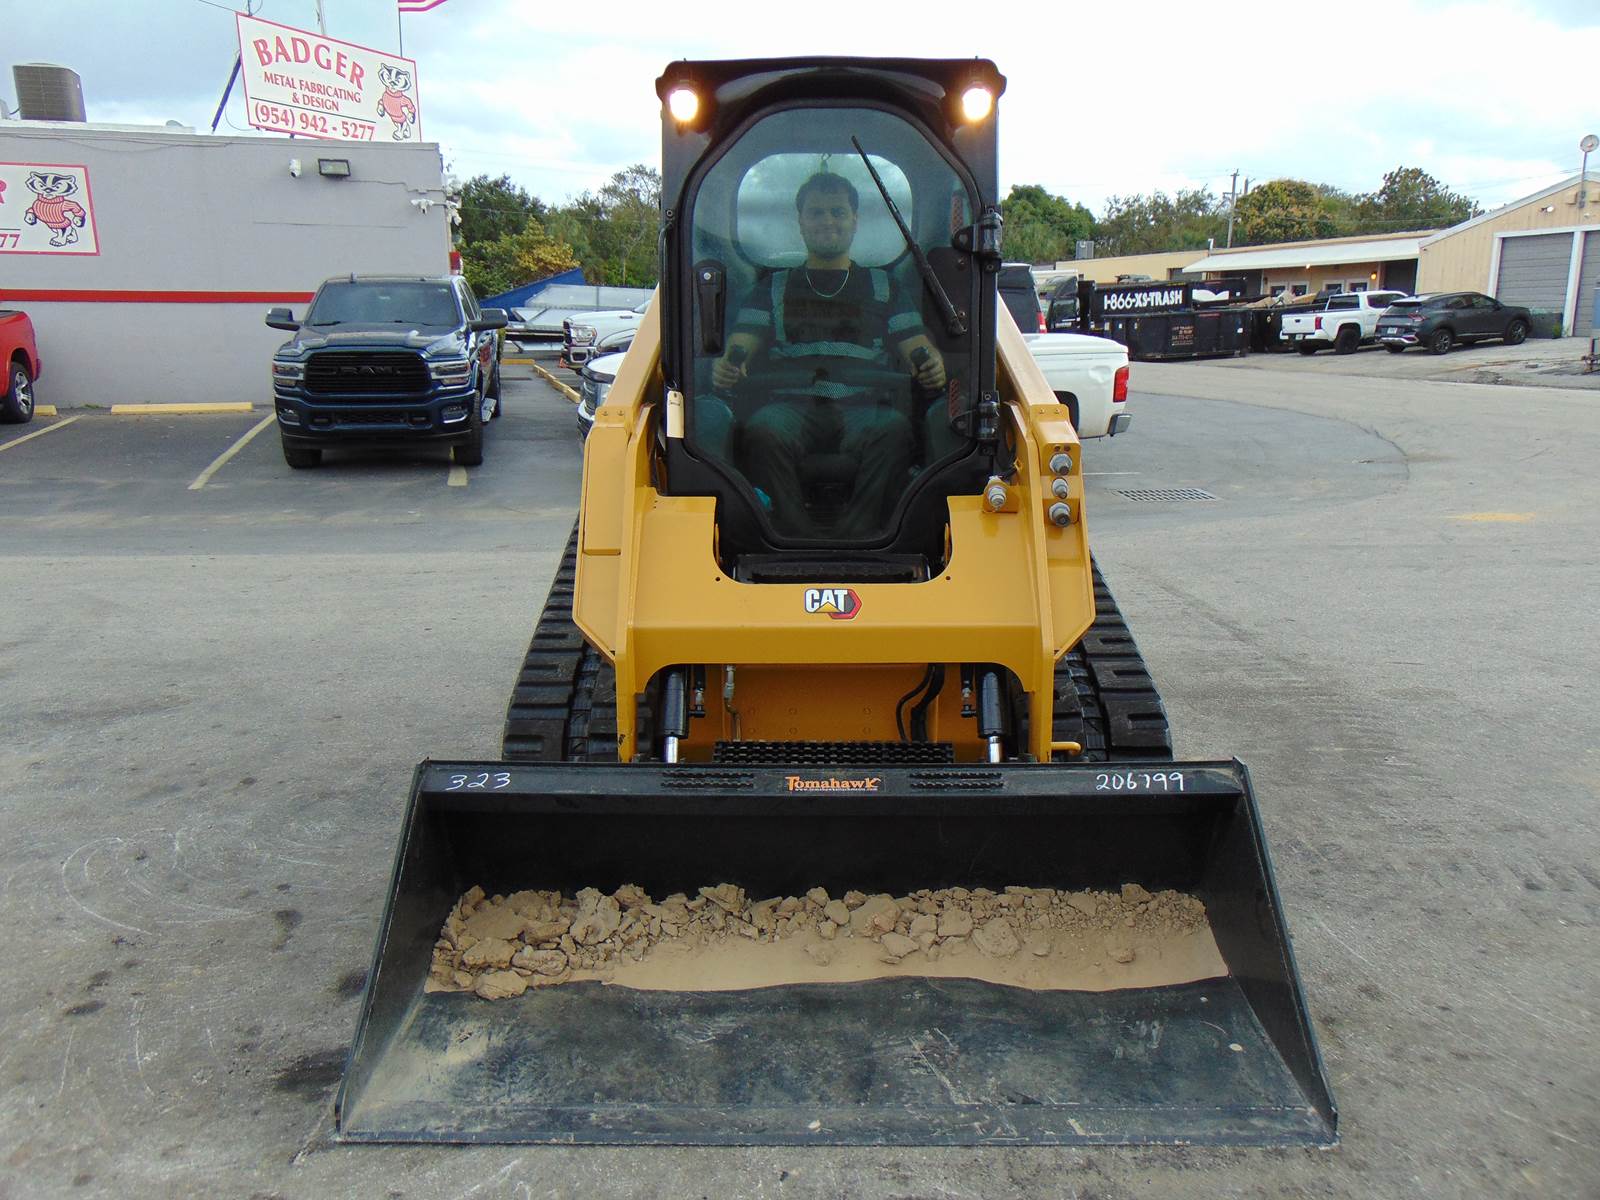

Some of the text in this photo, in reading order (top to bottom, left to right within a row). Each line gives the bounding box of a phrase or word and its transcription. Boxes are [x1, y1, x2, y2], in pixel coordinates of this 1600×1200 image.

[253, 36, 364, 91] BADGER
[263, 71, 362, 103] METAL FABRICATING
[292, 92, 340, 112] & DESIGN
[254, 102, 296, 128] (954)
[300, 112, 329, 134] 942
[341, 120, 376, 141] 5277
[805, 589, 848, 613] CAT
[445, 772, 511, 791] 323
[1095, 771, 1185, 792] 206799
